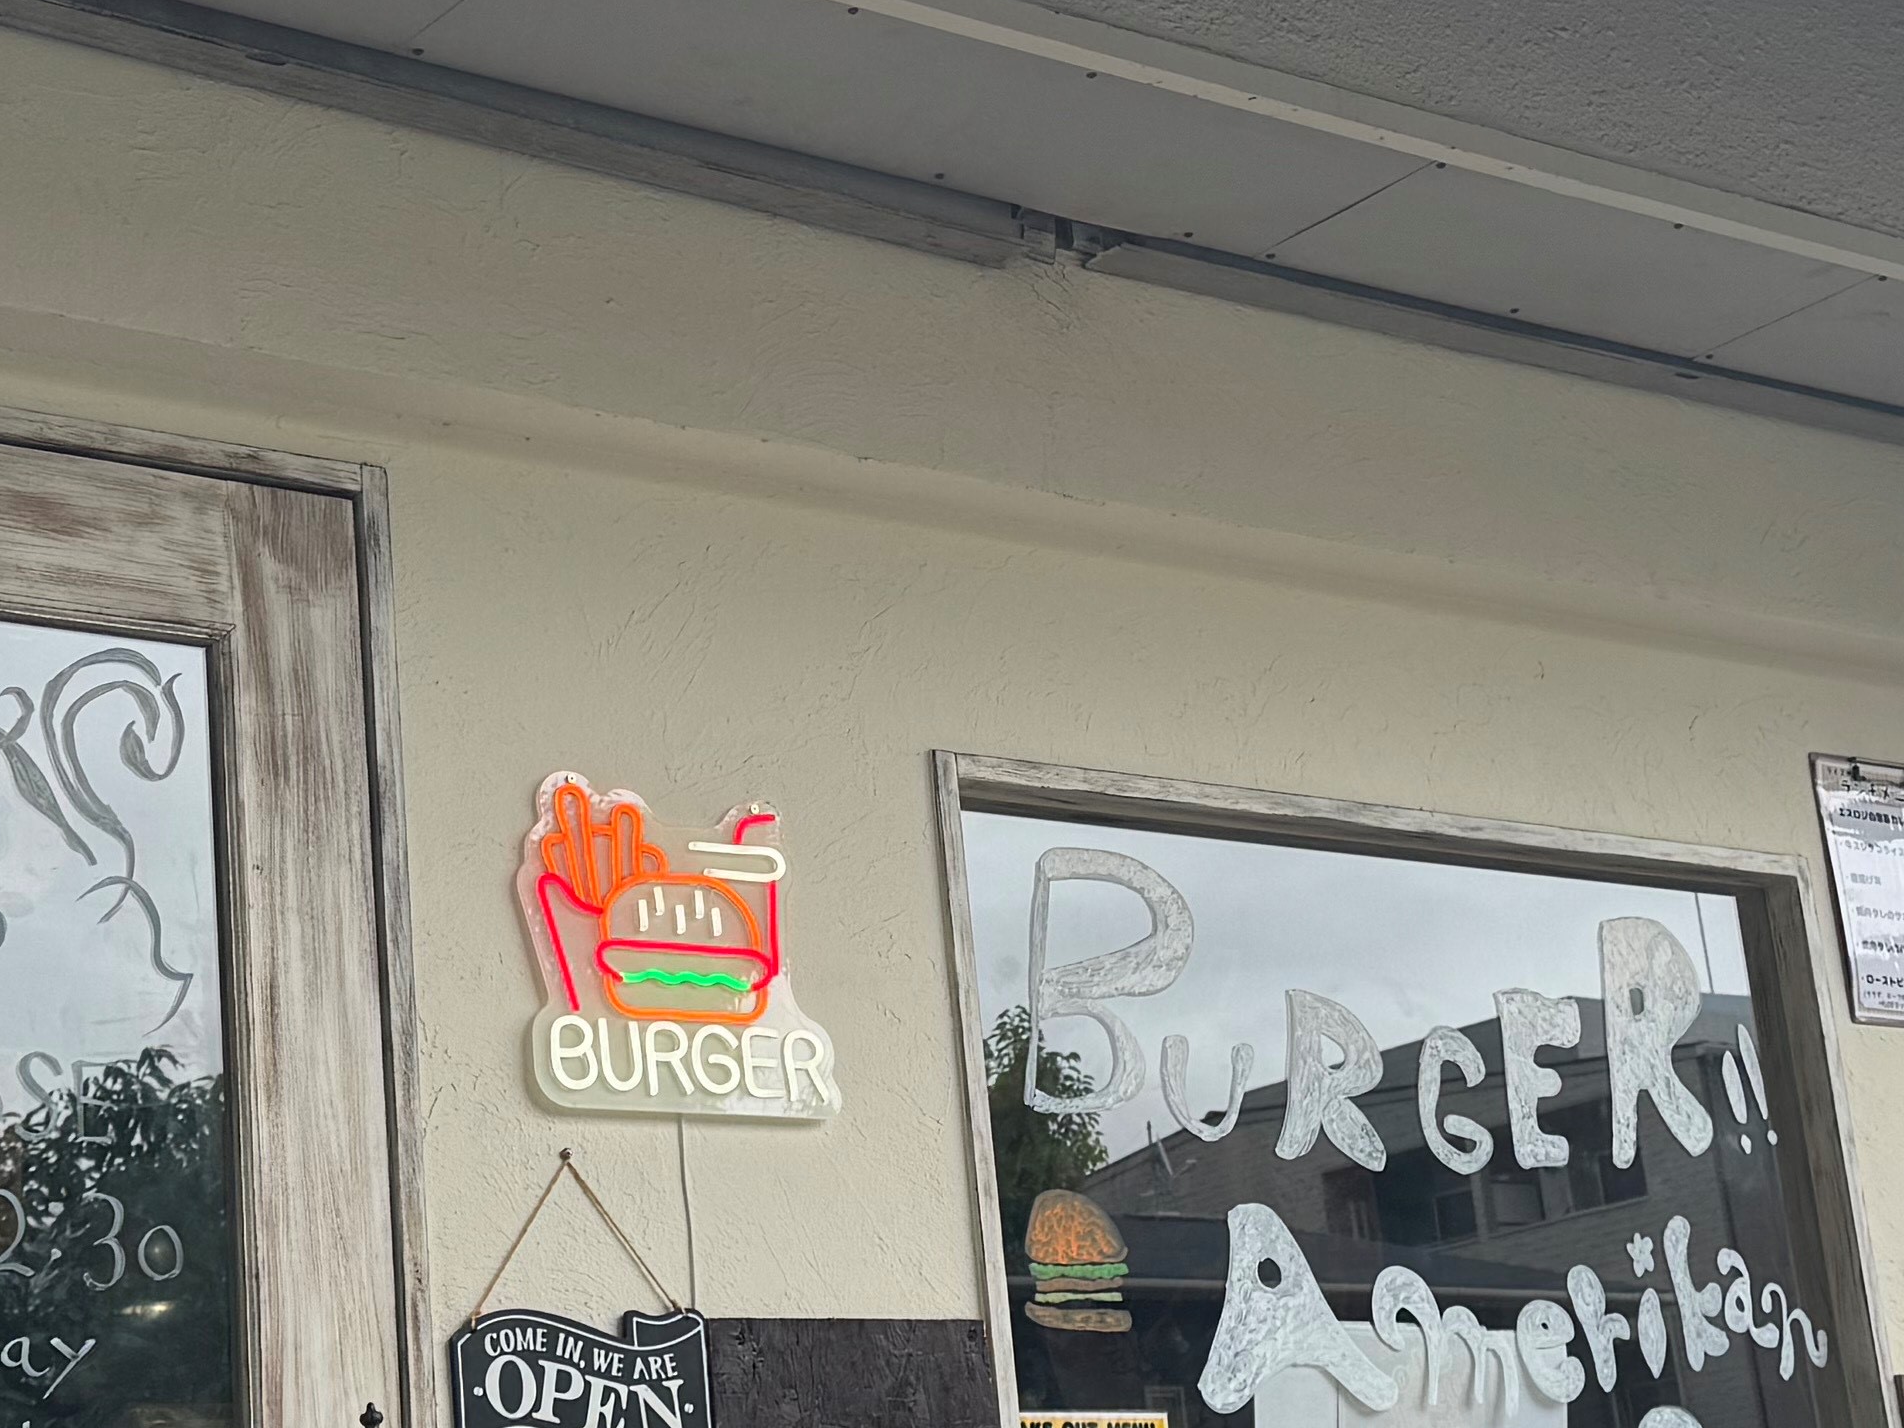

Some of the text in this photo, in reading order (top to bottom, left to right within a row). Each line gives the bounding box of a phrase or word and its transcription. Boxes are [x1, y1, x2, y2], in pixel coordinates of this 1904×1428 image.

[549, 1014, 830, 1105] BURGER
[484, 1327, 678, 1380] COME IN, WE ARE
